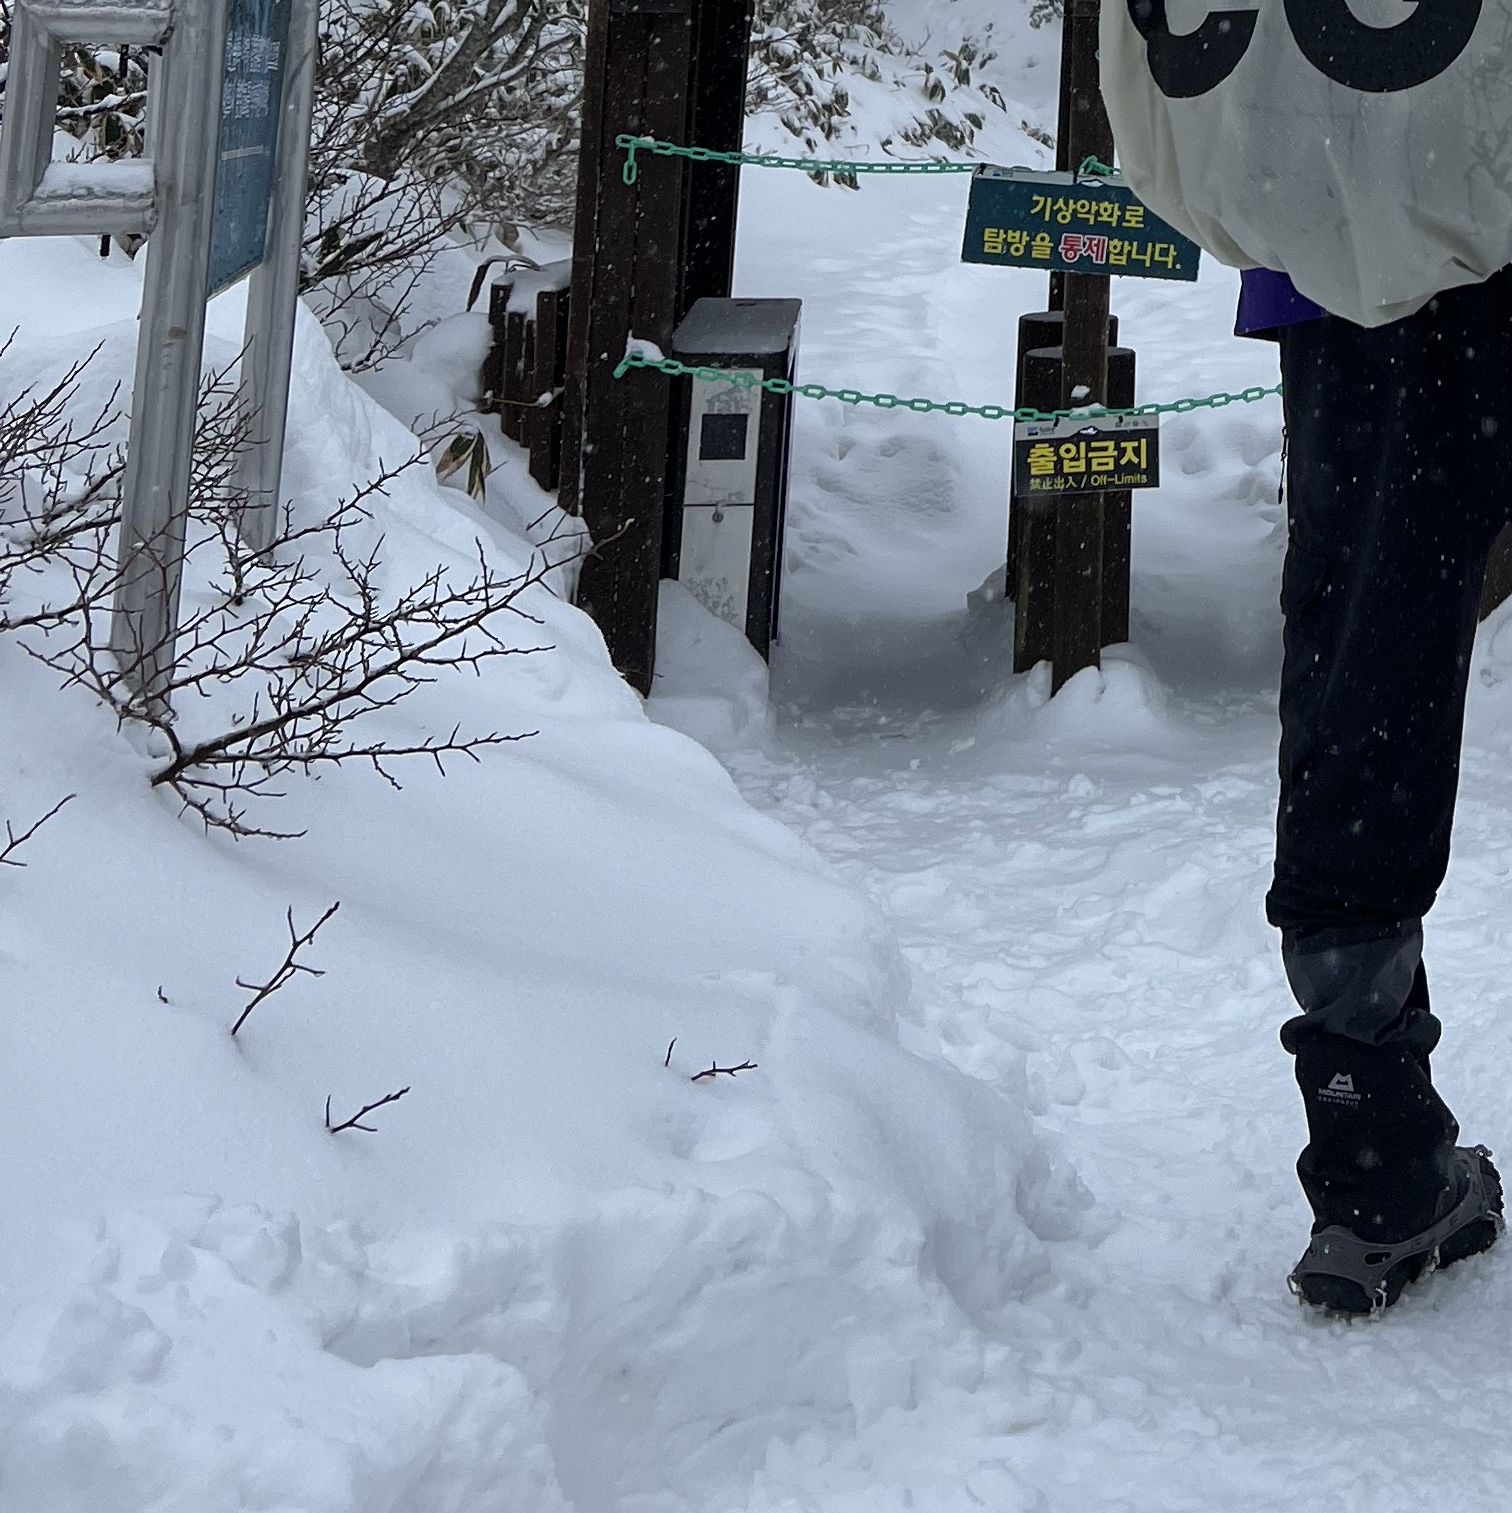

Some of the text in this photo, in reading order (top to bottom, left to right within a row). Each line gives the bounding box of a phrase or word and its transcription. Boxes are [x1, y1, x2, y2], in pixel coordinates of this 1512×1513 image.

[1030, 194, 1145, 228] 기상악화로
[983, 227, 1182, 270] 탐방을 통제합니다.
[1027, 438, 1147, 476] 출입금지
[1090, 472, 1147, 486] Off-Limits
